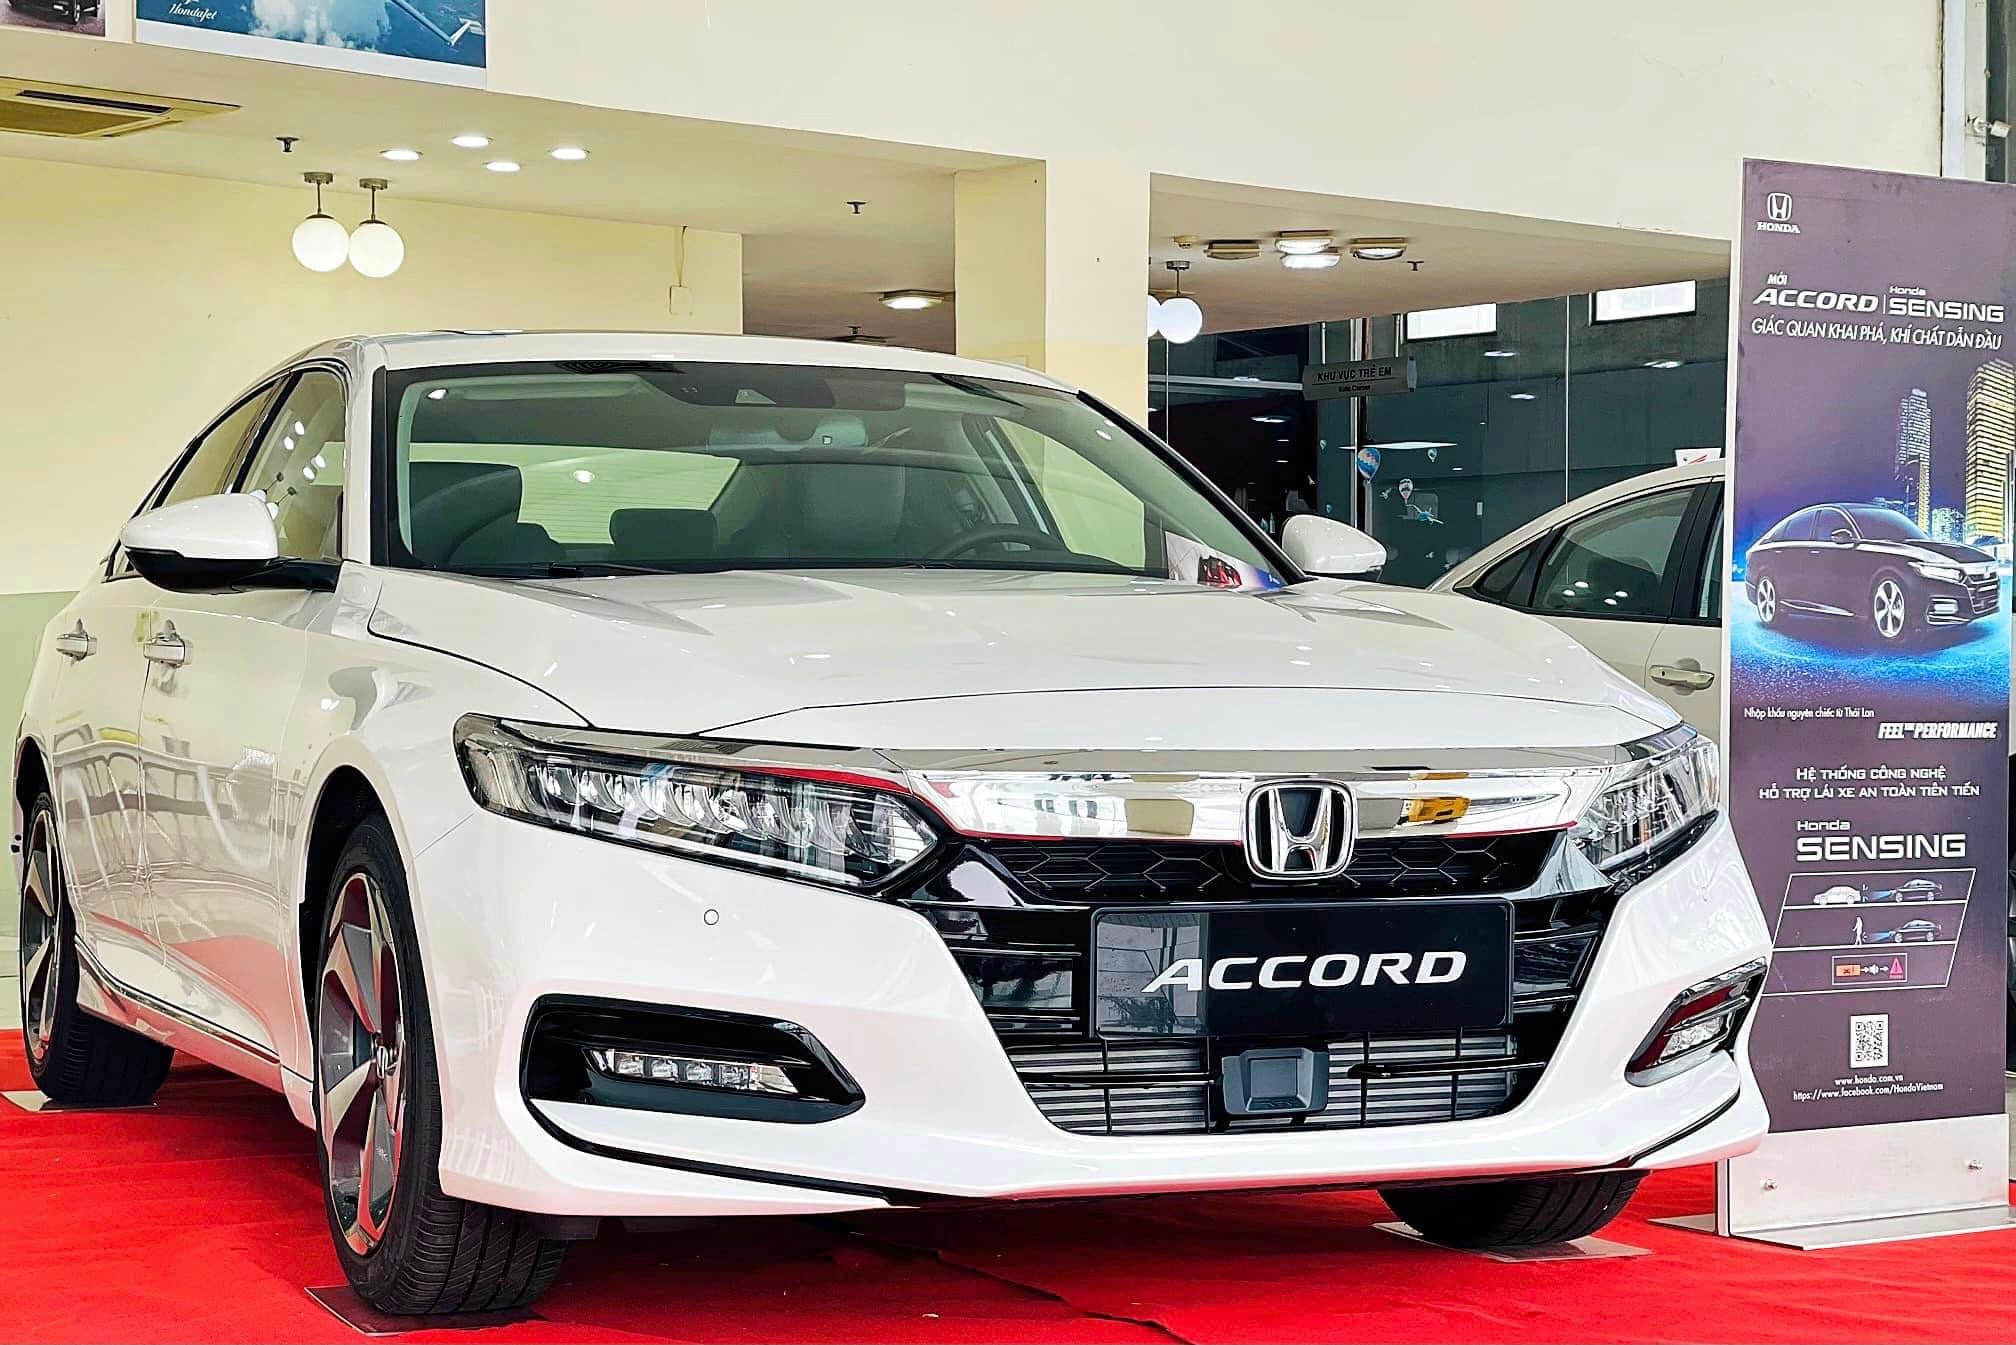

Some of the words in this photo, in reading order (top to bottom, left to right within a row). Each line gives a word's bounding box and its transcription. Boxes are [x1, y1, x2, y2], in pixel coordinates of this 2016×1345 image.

[168, 3, 218, 22] HondaJet
[1757, 222, 1801, 234] HONDA
[1768, 272, 1788, 285] MỚI
[1889, 286, 1927, 297] Honda
[1752, 288, 1879, 312] ACCORD
[1888, 297, 2005, 323] SENSING
[1751, 314, 1785, 336] GIÁC
[1786, 320, 1827, 339] QUAN
[1828, 323, 1858, 341] KHAI
[1859, 321, 1888, 345] PHÁ,
[1890, 324, 1913, 344] KHÍ
[1913, 325, 1946, 346] CHẤT
[1975, 328, 2003, 350] ĐẦU
[1317, 370, 1336, 382] KHU
[1378, 366, 1392, 376] EM
[1844, 706, 1861, 718] Thái
[1861, 707, 1875, 718] Lan
[1878, 722, 1905, 739] FEEL
[1913, 722, 1999, 739] PERFORMANCE
[1796, 766, 1818, 783] HỆ
[1820, 765, 1865, 780] THỐNG
[1870, 764, 1907, 779] CÔNG
[1910, 765, 1947, 781] NGHỆ
[1783, 787, 1812, 802] TRỢ
[1814, 785, 1834, 799] LÁI
[1838, 787, 1855, 798] XE
[1858, 787, 1877, 798] AN
[1880, 783, 1917, 798] TOÀN
[1920, 782, 1949, 797] TIÊN
[1951, 781, 1981, 797] TIẾN
[1796, 819, 1851, 832] Honda
[1796, 834, 1967, 862] SENSING
[1141, 951, 1468, 994] ACCORD
[1834, 1074, 1904, 1086] www.honda.com.vn
[1793, 1083, 1945, 1103] https://www.facebook.com/HondaVietnam
